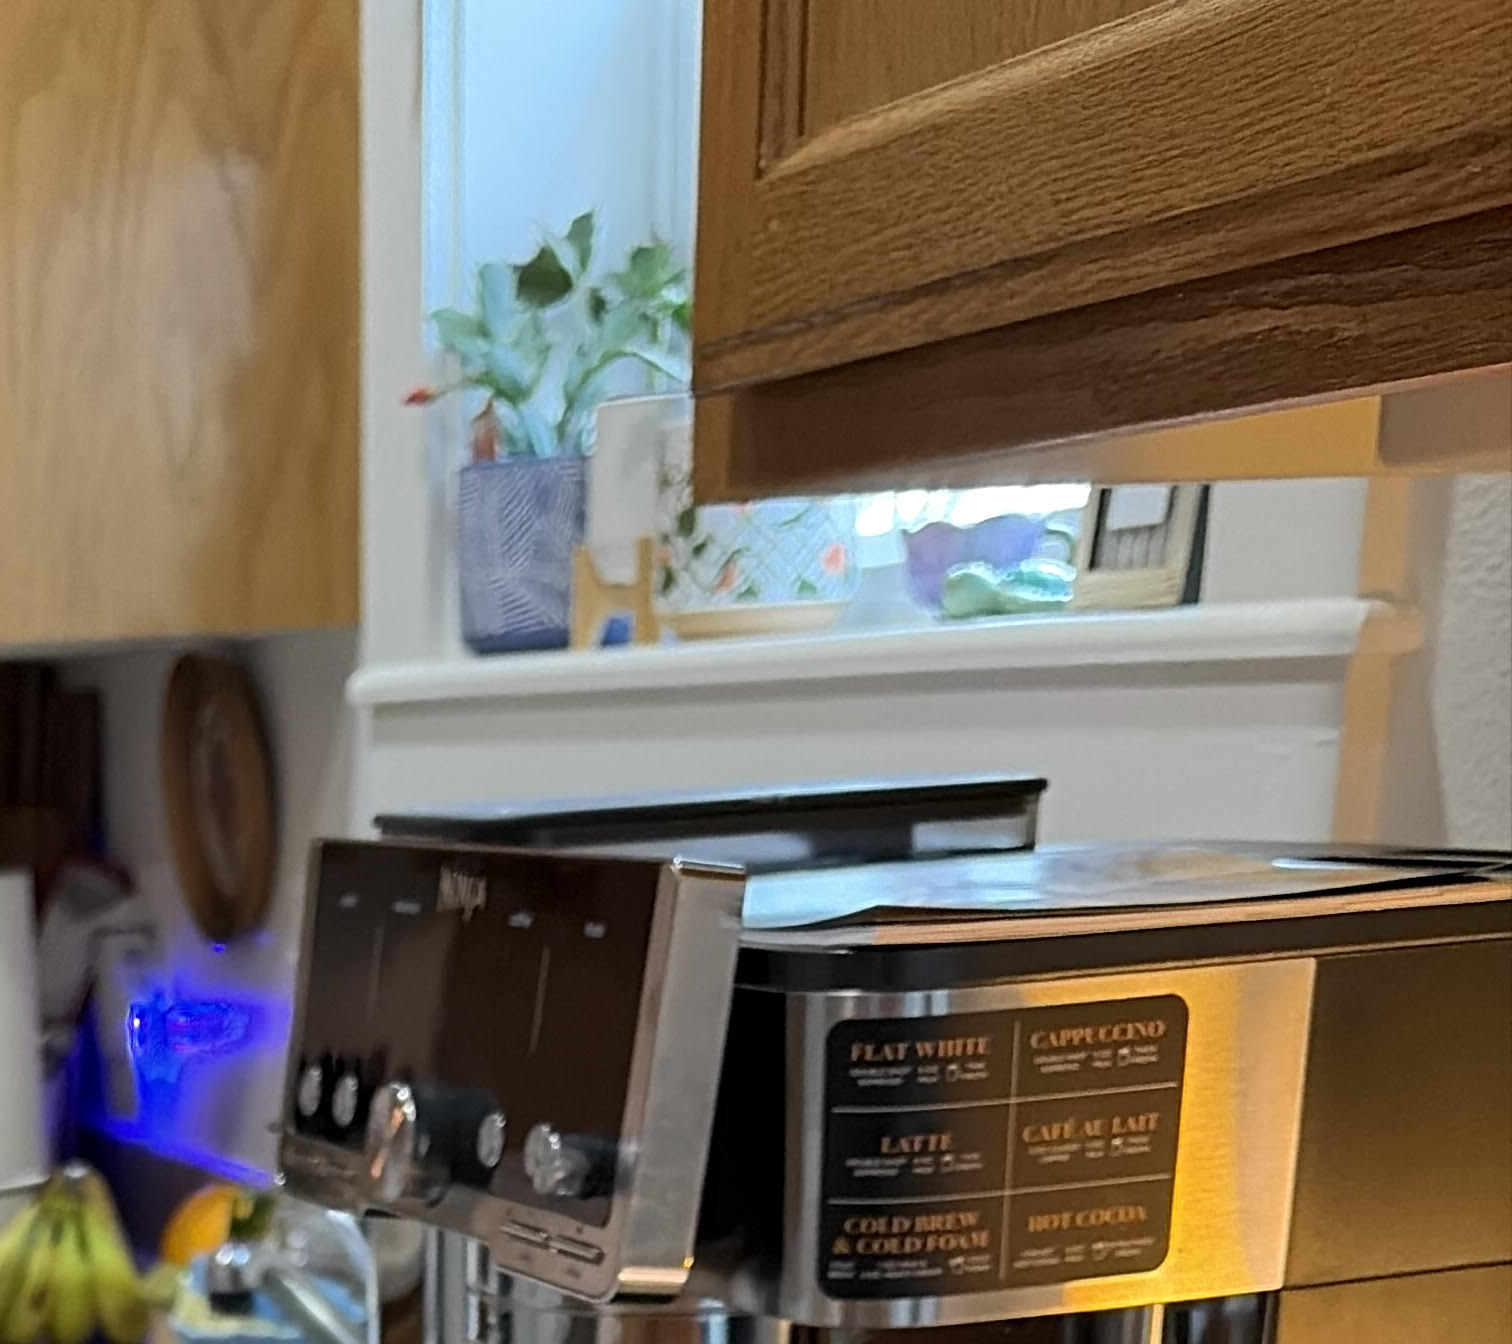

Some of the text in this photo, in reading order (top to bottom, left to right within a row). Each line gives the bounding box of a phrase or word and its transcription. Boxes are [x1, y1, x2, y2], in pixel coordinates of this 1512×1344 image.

[1029, 1020, 1166, 1049] CAPPUCCINO
[850, 1037, 991, 1061] FLAT WHITE
[1111, 1112, 1159, 1134] LAIT
[880, 1132, 951, 1153] LATTE
[843, 1211, 981, 1234] COLD BREW
[855, 1234, 923, 1255] COLD
[925, 1229, 990, 1253] FOAM
